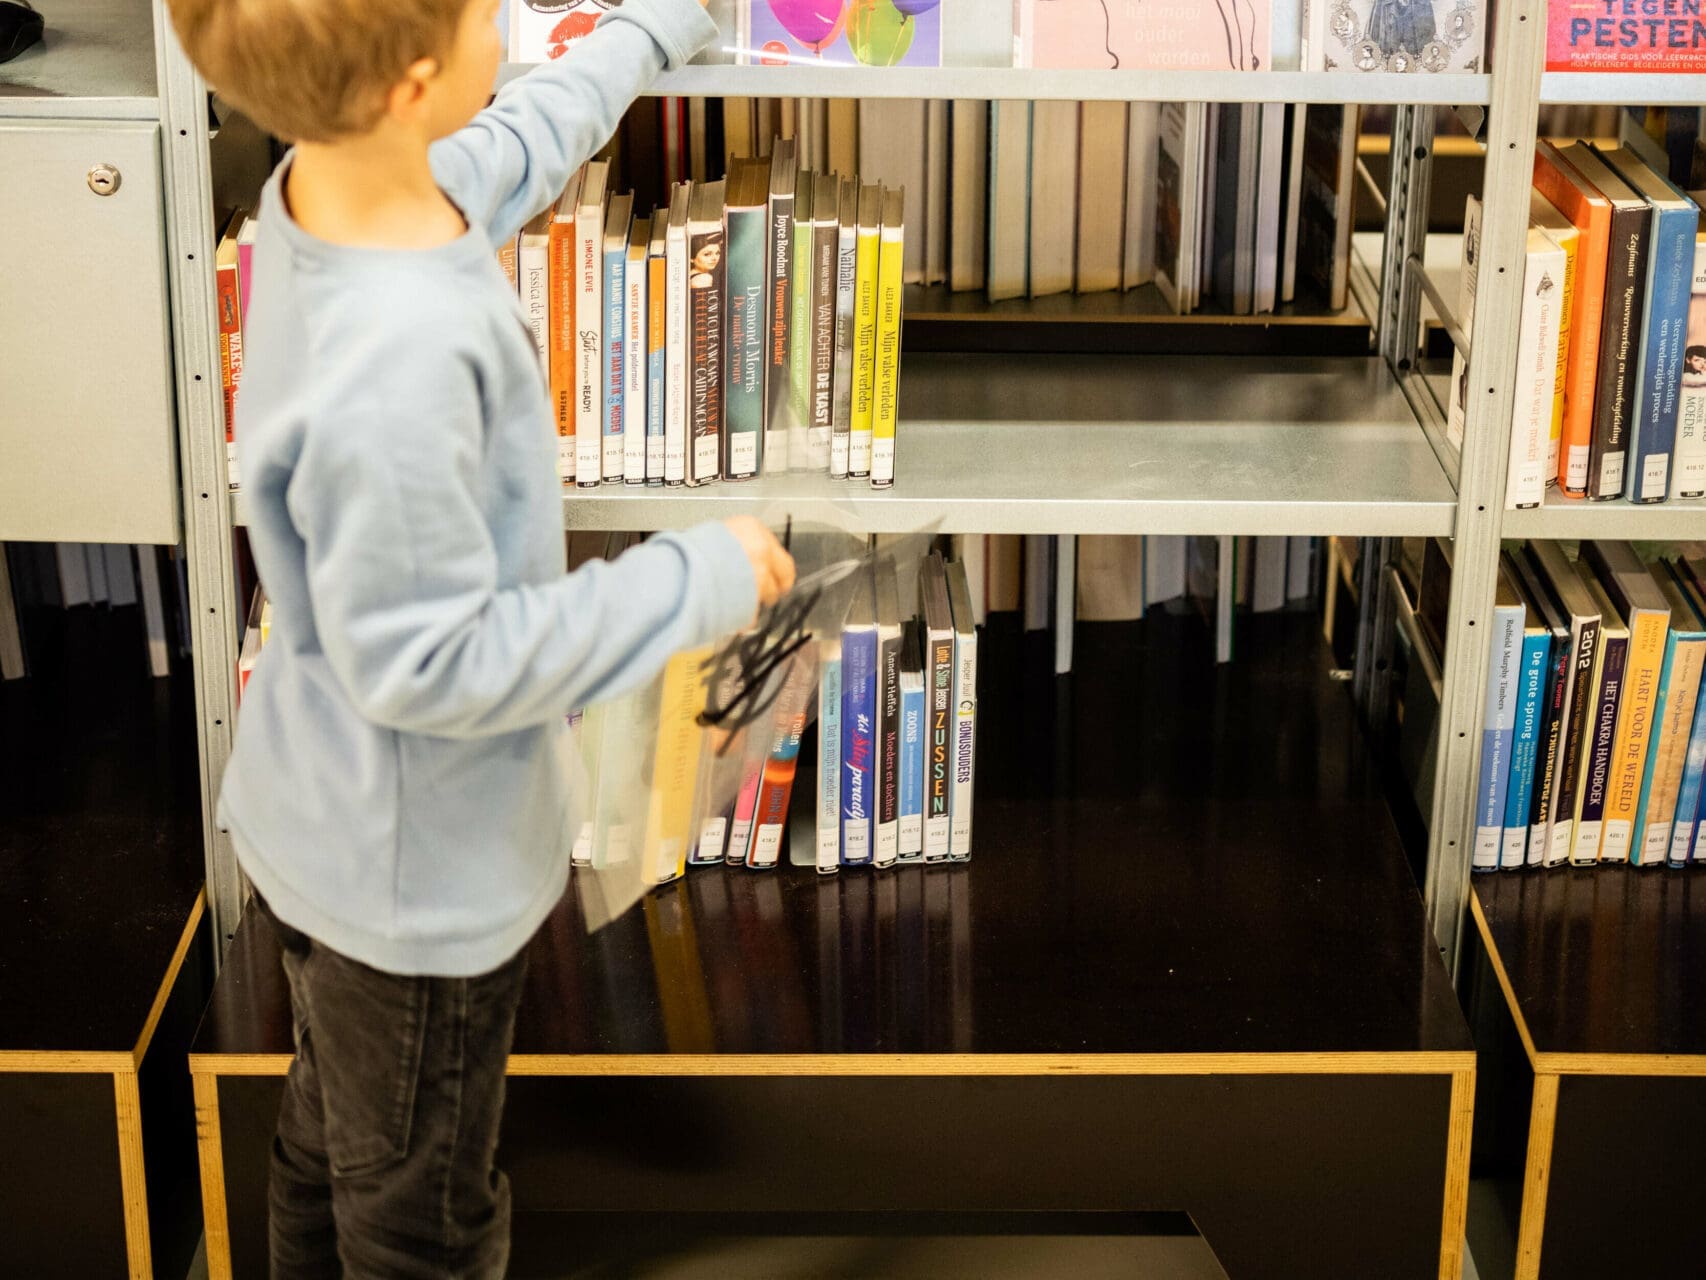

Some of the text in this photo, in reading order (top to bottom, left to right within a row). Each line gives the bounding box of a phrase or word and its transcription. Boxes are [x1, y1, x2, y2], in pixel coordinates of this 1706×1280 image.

[1571, 52, 1618, 60] PRAKTISCHE
[585, 240, 593, 293] SIMONE LEVIE
[773, 215, 789, 365] Joyce Roodnat Vrouwen zijn leuker
[839, 248, 855, 292] Nathalie
[229, 332, 242, 387] WAKE-UP
[732, 295, 744, 384] De naakte vrouw
[745, 286, 761, 393] Desmond Morris
[815, 304, 831, 424] VAN ACHTER DE KAST
[857, 324, 872, 413] Mijn valse verleden
[879, 330, 894, 420] Mijn valse verleden
[1663, 318, 1683, 414] Stervensbegeleiding
[1683, 396, 1696, 438] MOEDER
[1498, 619, 1514, 710] Redfield Murphy Timbers
[1578, 630, 1594, 669] 2012
[905, 710, 918, 743] ZOONS
[1521, 652, 1543, 739] De grote sprong
[1596, 704, 1615, 746] CHAKRA
[1605, 681, 1618, 701] HET
[932, 711, 948, 813] ZUSSEN
[957, 720, 973, 784] BONUSOUDERS
[1588, 748, 1610, 805] HANDBOEK
[1618, 668, 1653, 812] HART VOOR DE WERELD
